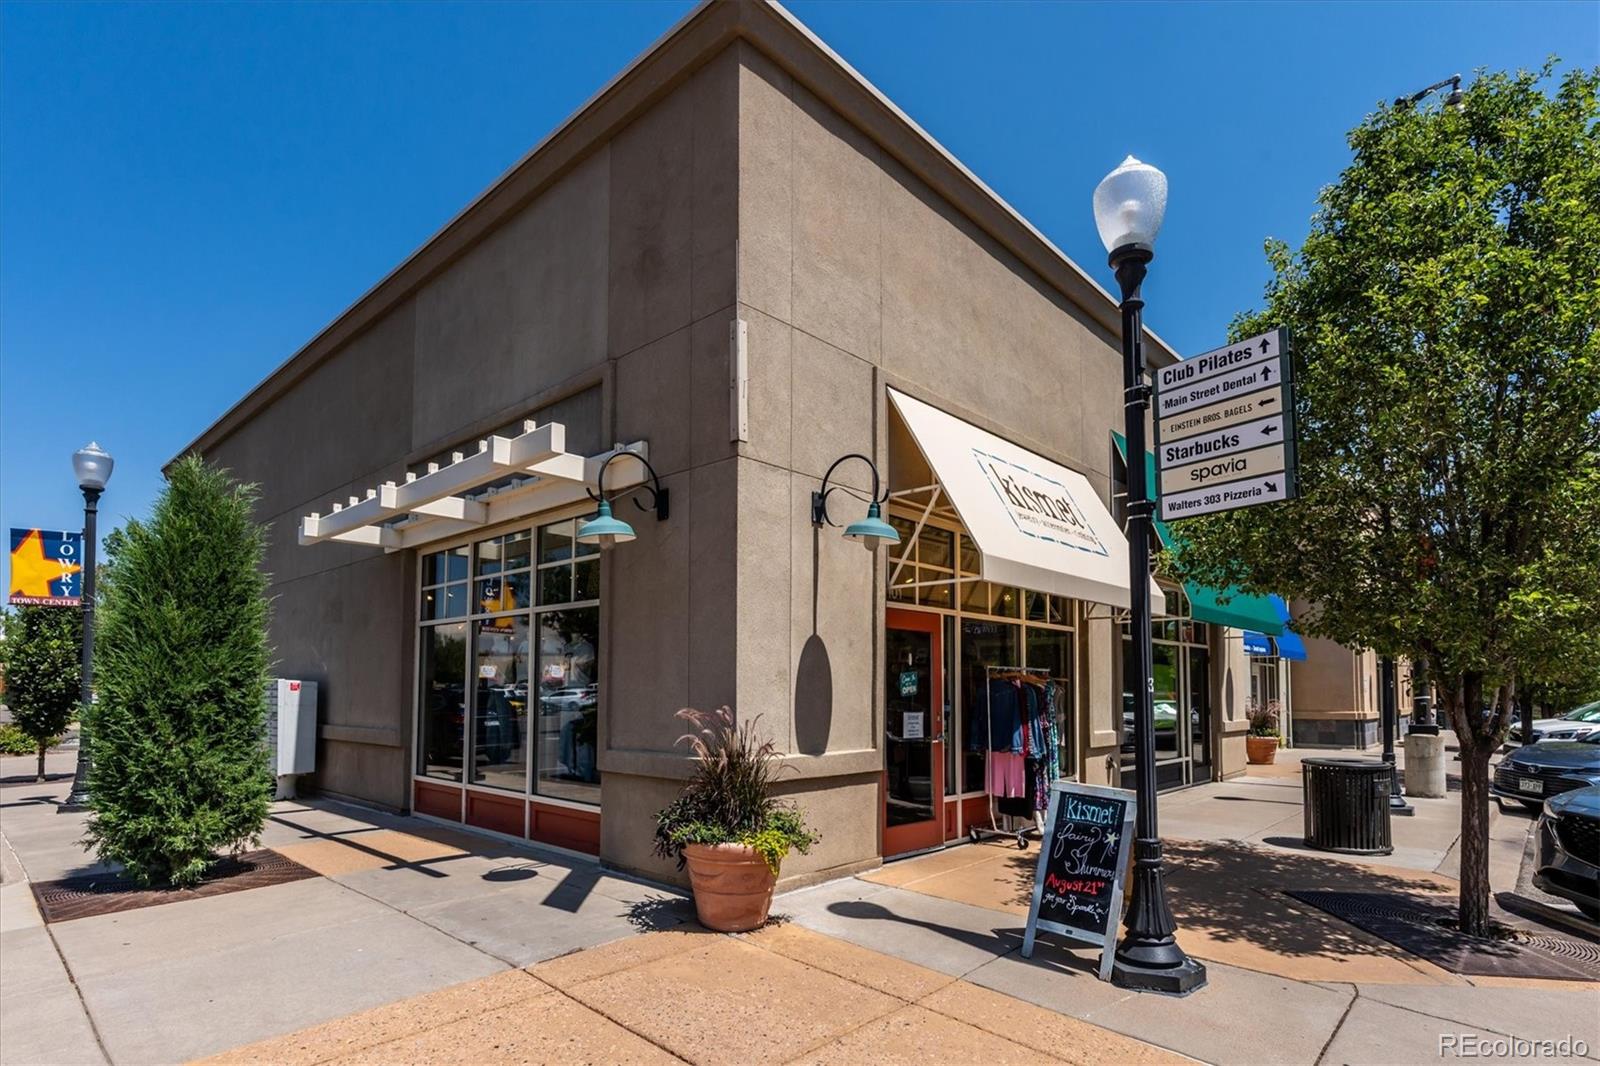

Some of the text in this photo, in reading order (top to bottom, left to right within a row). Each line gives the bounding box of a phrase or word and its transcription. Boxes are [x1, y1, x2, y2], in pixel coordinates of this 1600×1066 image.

[1163, 347, 1252, 385] Club Pilates
[1164, 372, 1257, 409] Main Street Dental
[1170, 418, 1201, 433] EINSTEIN
[1224, 403, 1253, 418] BAGELS
[1166, 434, 1240, 462] Starbucks
[1190, 458, 1247, 482] spavia
[988, 463, 1085, 529] kismet
[1168, 486, 1262, 512] Walters 303 Pizzeria
[57, 531, 77, 597] LOWRY
[11, 597, 80, 606] TOWN CENTER
[1066, 798, 1115, 825] Kismet
[1045, 872, 1083, 894] August
